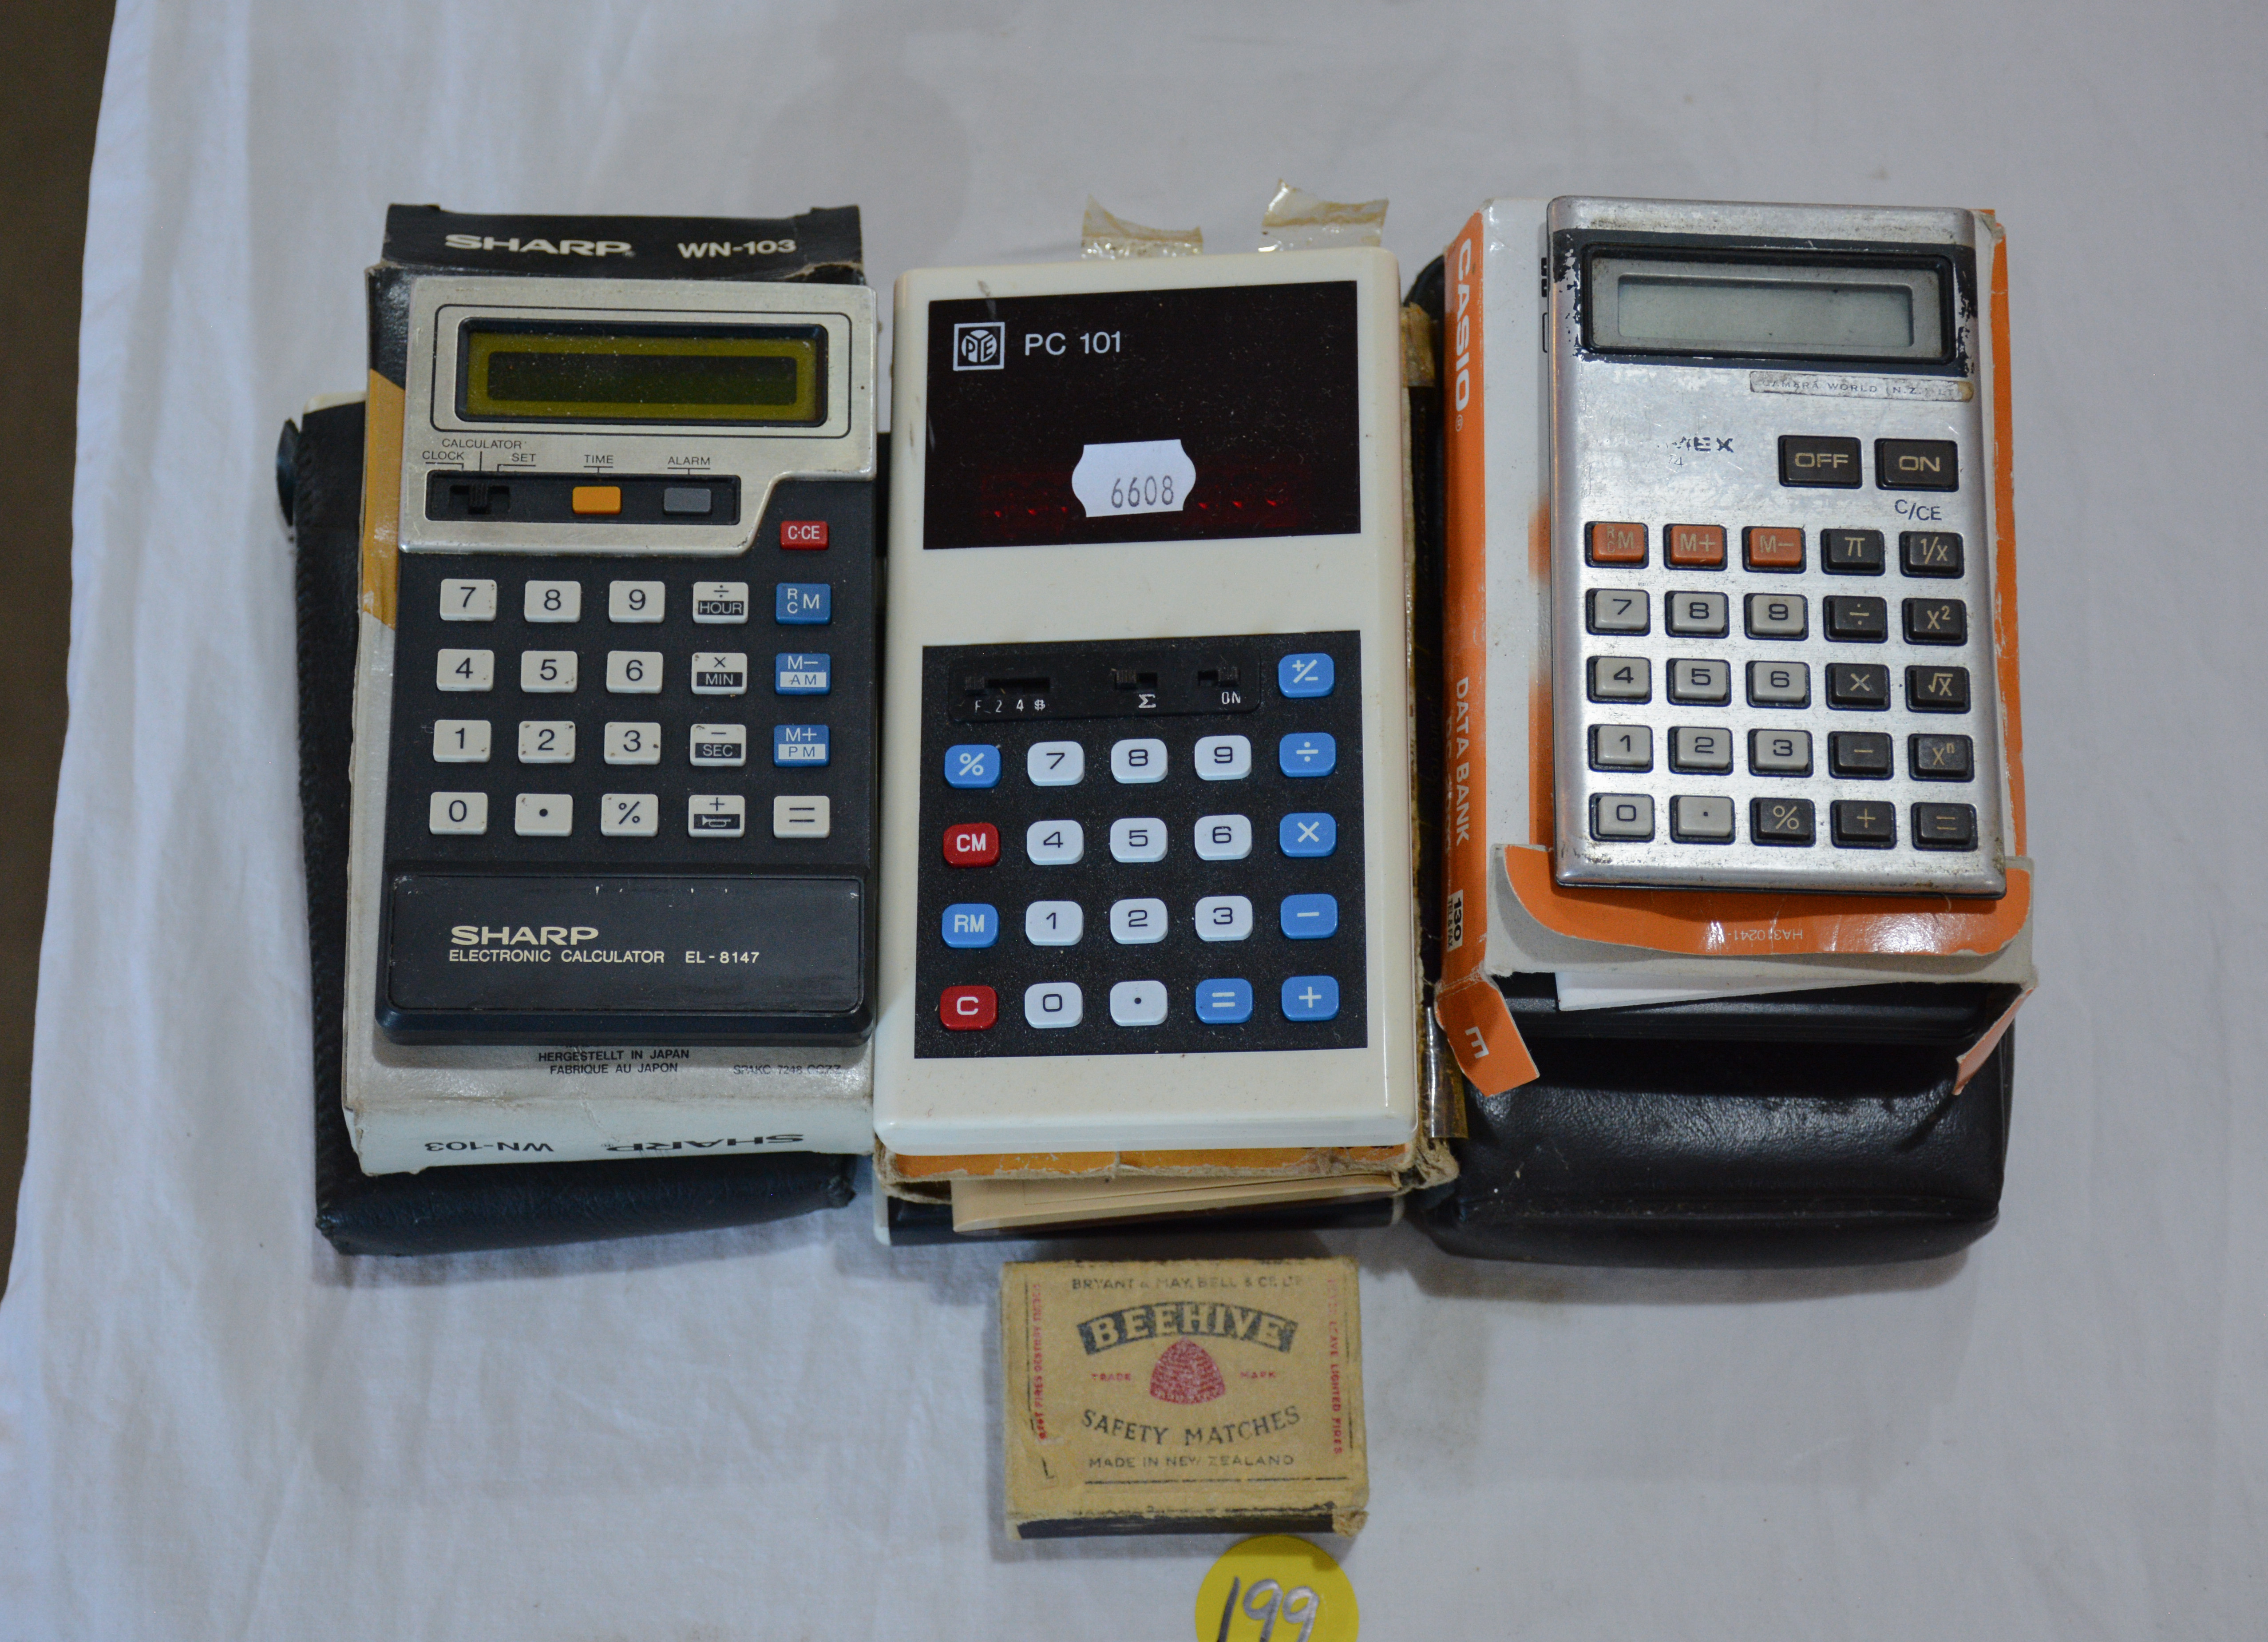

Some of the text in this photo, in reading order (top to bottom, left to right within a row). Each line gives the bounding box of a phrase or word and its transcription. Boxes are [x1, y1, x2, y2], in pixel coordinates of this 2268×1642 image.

[678, 239, 796, 258] WN-103
[959, 328, 999, 364] PYE
[1025, 331, 1120, 355] PC 101
[1828, 382, 1878, 393] WORLD
[442, 438, 522, 449] CALCULATOR
[422, 450, 464, 460] CLOCK
[512, 453, 536, 462] SET
[585, 455, 613, 464] TIME
[668, 456, 710, 465] ALARM
[1795, 452, 1940, 472] OFF ON
[1111, 475, 1174, 508] 6608
[1894, 499, 1942, 521] C/CE
[1679, 535, 1716, 552] M+
[460, 587, 476, 608] 7
[544, 589, 561, 611] 8
[629, 589, 646, 611] 9
[700, 602, 742, 614] HOUR
[1613, 599, 1632, 615] 7
[1689, 602, 1710, 619] 8
[1768, 603, 1789, 621] 9
[455, 657, 473, 679] 4
[540, 659, 557, 681] 5
[626, 659, 643, 682] 6
[705, 673, 733, 685] MIN
[1613, 666, 1634, 684] 4
[1691, 668, 1711, 686] 5
[1770, 670, 1790, 688] 6
[996, 700, 1002, 713] 2
[1016, 698, 1024, 712] 4
[1221, 691, 1241, 705] ON
[455, 727, 465, 749] 1
[538, 729, 555, 751] 2
[623, 730, 641, 752] 3
[786, 727, 817, 742] M+
[703, 744, 732, 757] SEC
[1620, 734, 1631, 752] 1
[1694, 736, 1714, 754] 2
[1773, 739, 1793, 757] 3
[959, 753, 985, 776] %
[1046, 752, 1065, 769] 7
[1128, 749, 1148, 767] 8
[1214, 746, 1233, 764] 9
[1457, 677, 1469, 845] DATA BANK
[448, 800, 467, 822] 0
[618, 801, 641, 825] %
[1616, 804, 1637, 822] 0
[1773, 805, 1799, 830] %
[956, 833, 986, 852] CM
[1043, 831, 1064, 848] 4
[1129, 829, 1148, 847] 5
[1212, 826, 1232, 844] 6
[954, 914, 985, 933] RM
[1046, 912, 1056, 929] 1
[1128, 909, 1148, 928] 2
[1213, 907, 1233, 925] 3
[1454, 897, 1463, 941] 130
[451, 925, 599, 945] SHARP
[449, 949, 551, 962] ELECTRONIC
[561, 949, 665, 963] CALCULATOR
[957, 996, 979, 1015] C
[1042, 993, 1063, 1012] 0
[538, 1049, 689, 1062] HERGESTELLT IN JAPAN
[550, 1063, 678, 1074] FABRIQUE AU JAPON
[424, 1142, 554, 1152] WN-103
[1089, 1304, 1286, 1349] BEEHIVE
[1092, 1373, 1131, 1381] TRADE
[1331, 1364, 1341, 1412] LIGHTED
[1082, 1406, 1300, 1446] SAFETY MATCHES
[1089, 1455, 1294, 1468] MADE IN NEW ZEALAND
[1217, 1576, 1320, 1642] 199
